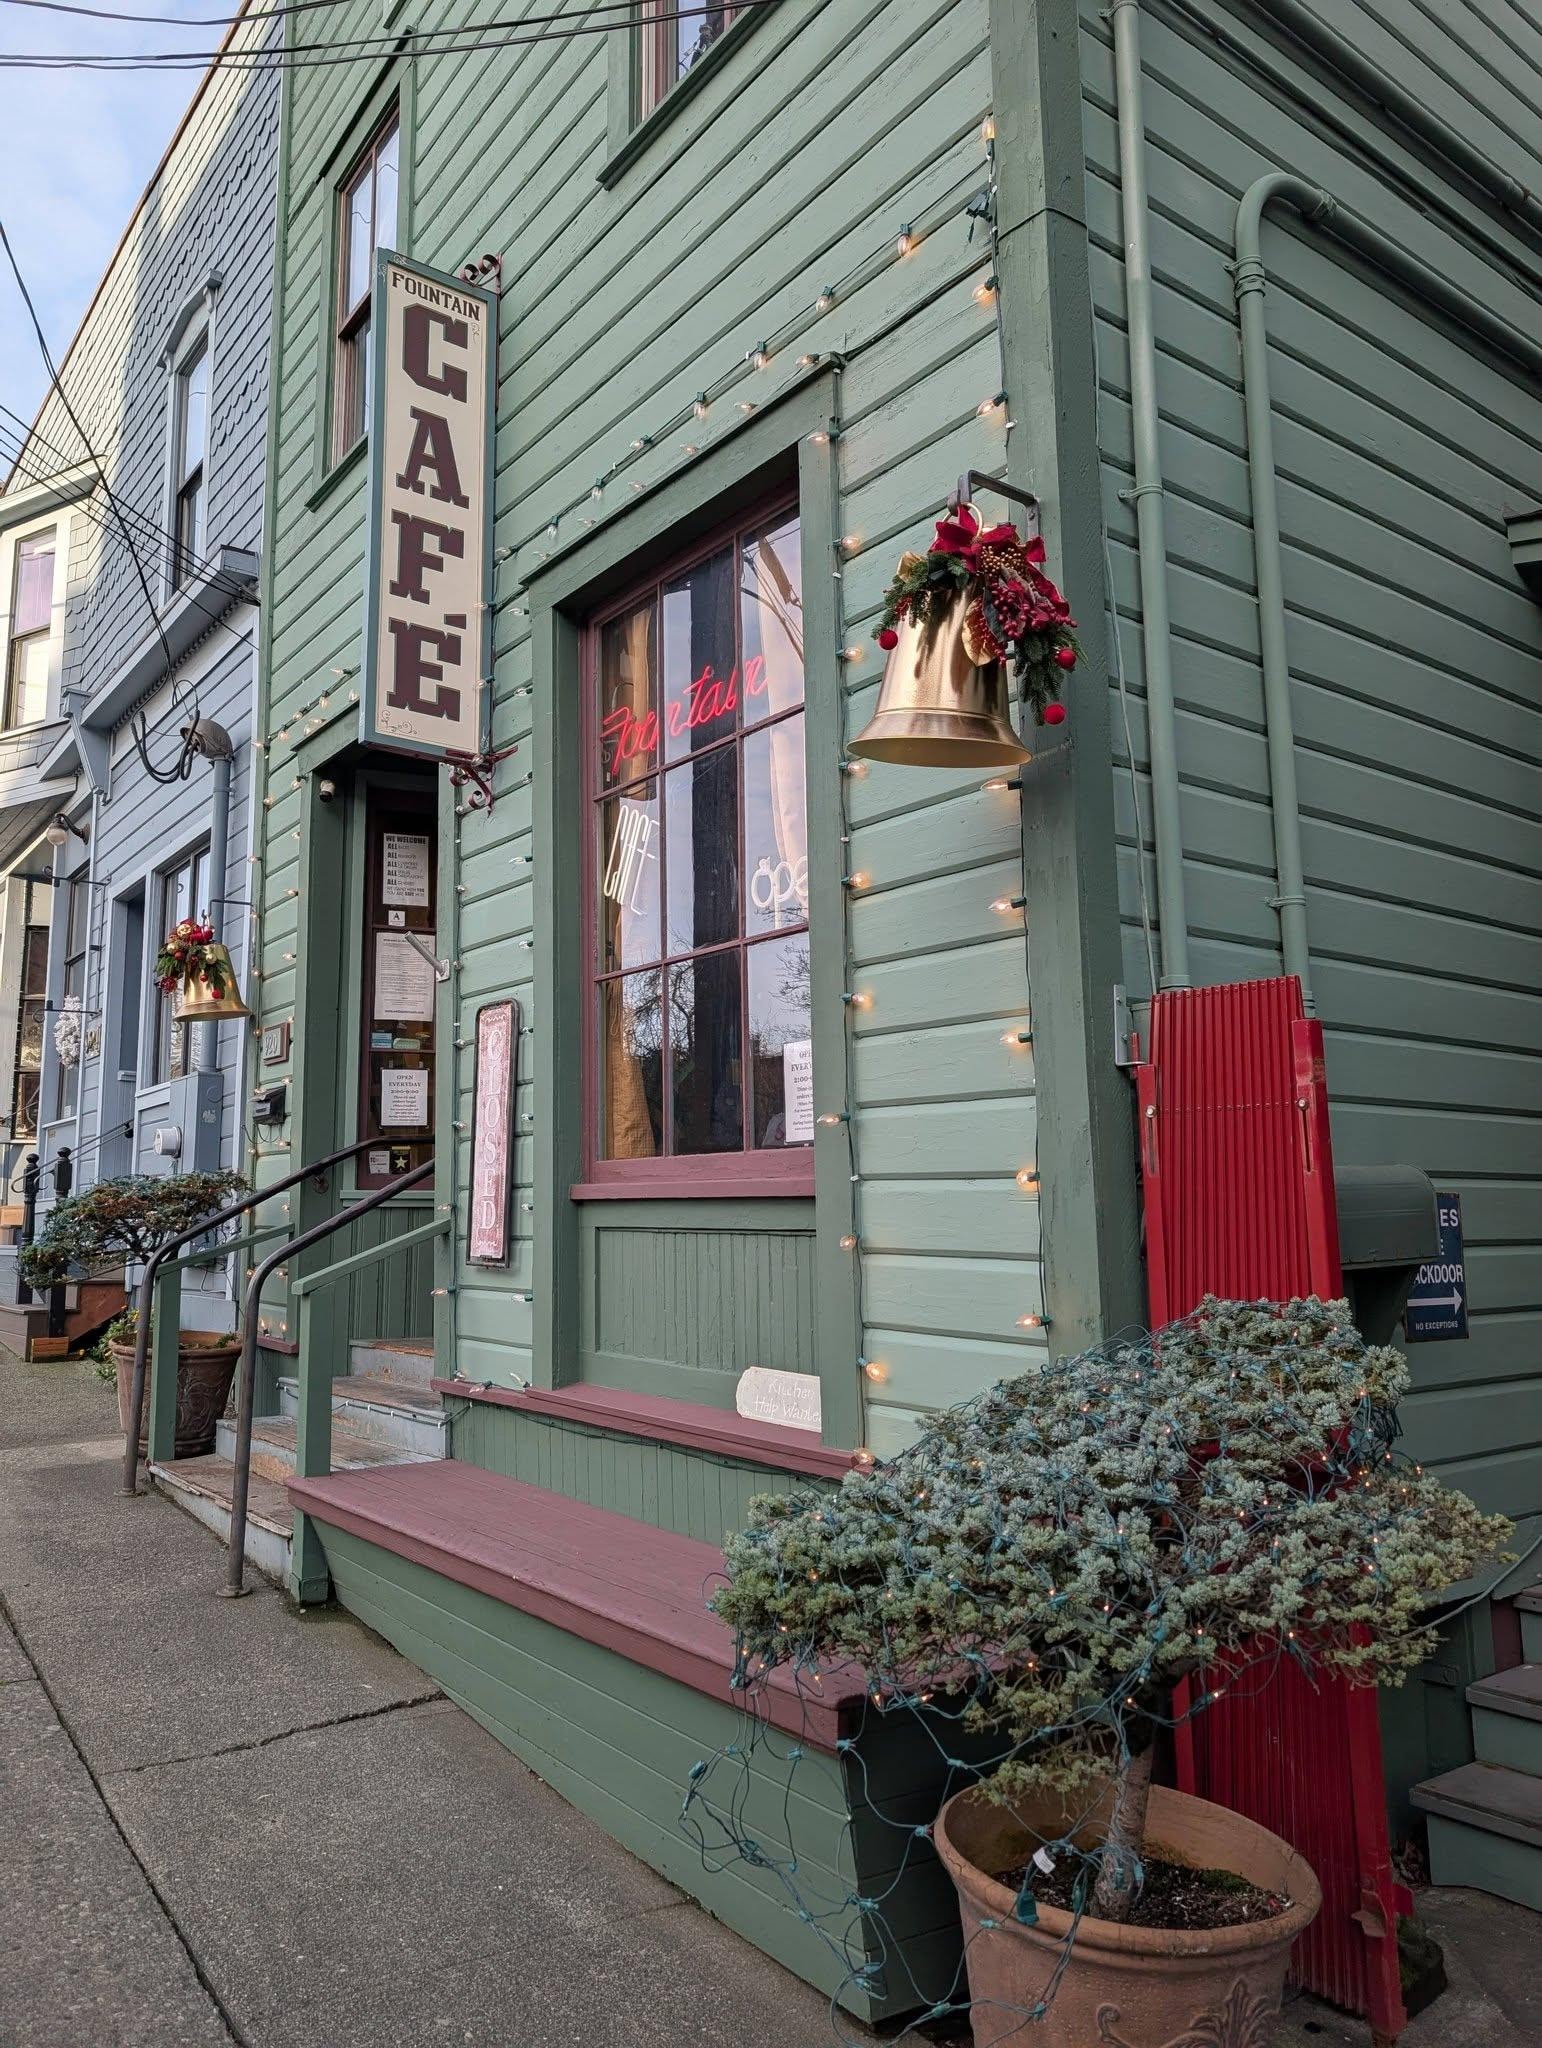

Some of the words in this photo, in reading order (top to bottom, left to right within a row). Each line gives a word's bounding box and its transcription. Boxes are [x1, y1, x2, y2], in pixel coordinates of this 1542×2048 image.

[391, 269, 481, 321] FOUNTAIN
[386, 302, 470, 722] CAFÉ
[601, 655, 767, 775] Fountain
[397, 836, 426, 844] WELCOME
[393, 912, 400, 920] A
[480, 1028, 503, 1230] CLOSED
[1415, 1322, 1424, 1331] NO
[1425, 1320, 1459, 1330] EXCEPTIONS
